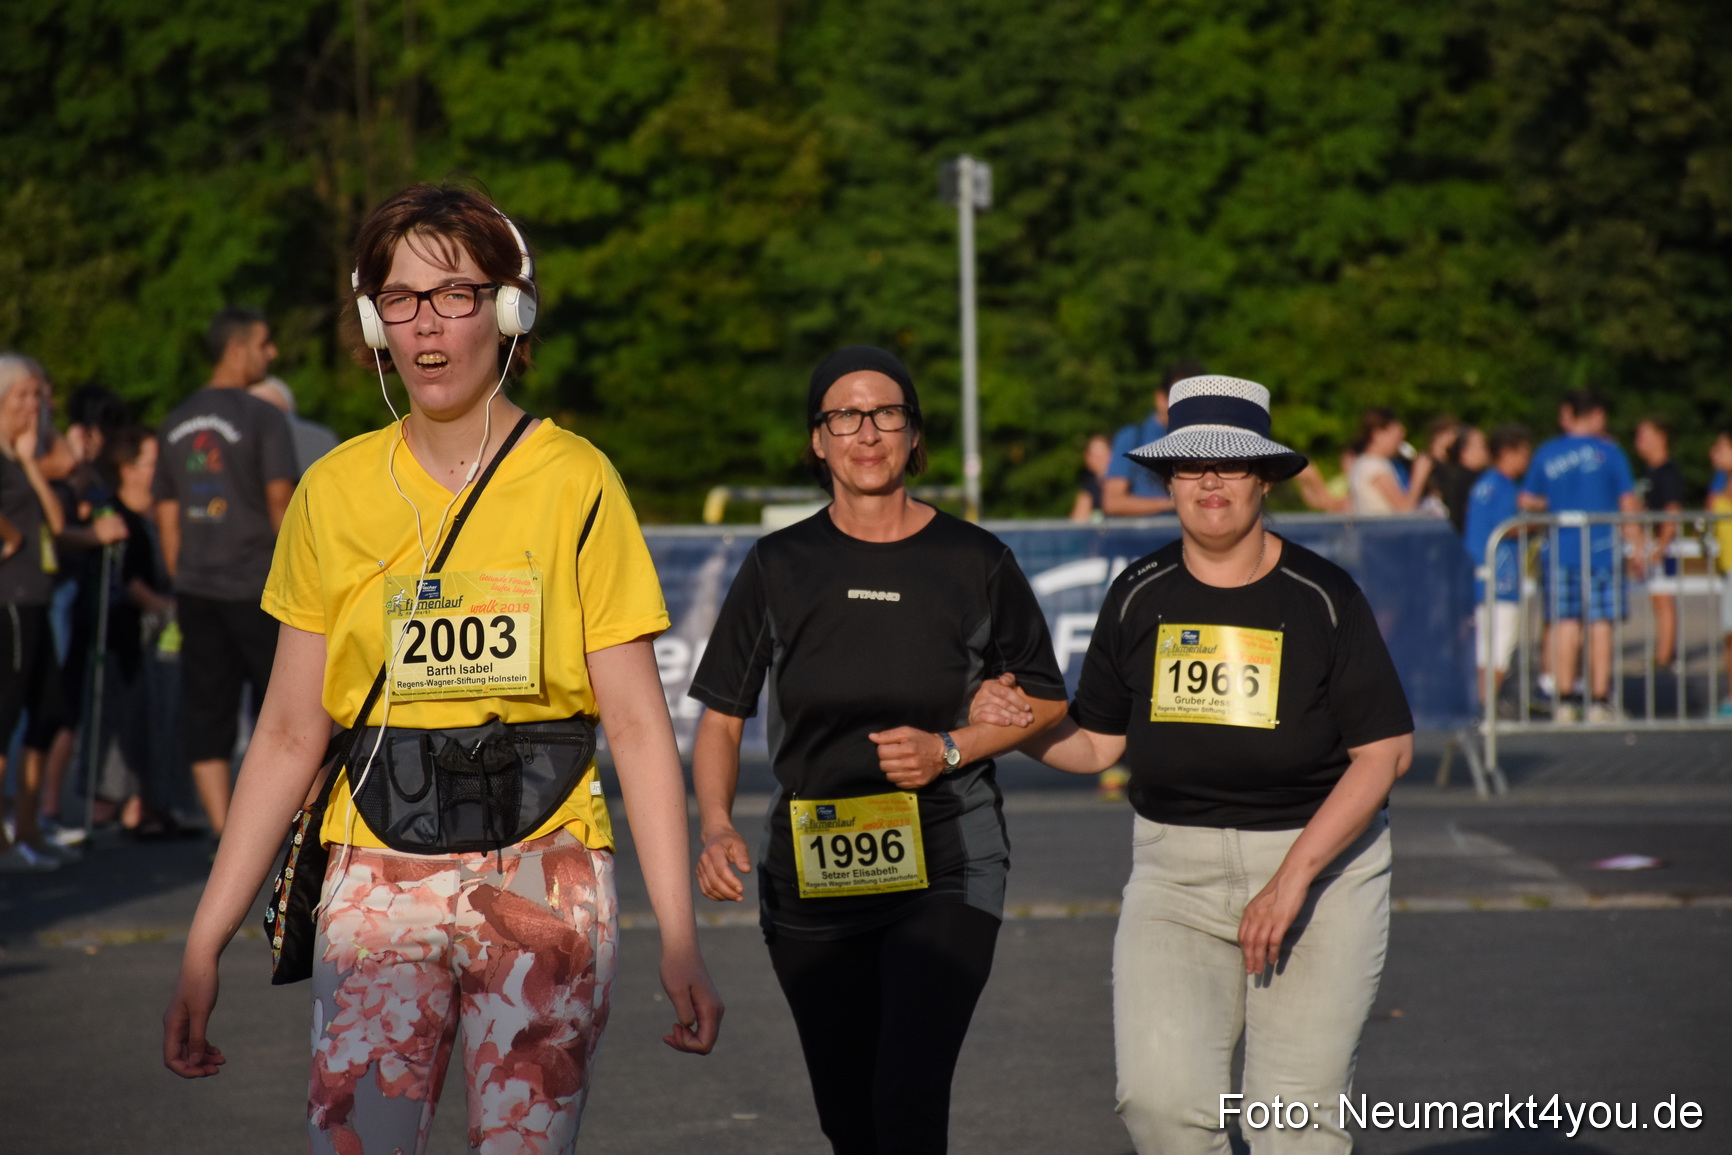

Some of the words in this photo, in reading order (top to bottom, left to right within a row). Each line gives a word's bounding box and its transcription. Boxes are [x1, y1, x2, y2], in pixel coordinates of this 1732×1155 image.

[405, 595, 464, 611] fimenlauf
[470, 600, 498, 614] walk
[500, 603, 530, 613] 2019
[402, 614, 517, 664] 2003
[1247, 655, 1272, 666] 2019
[426, 665, 456, 677] Barth
[459, 663, 493, 675] Isabel
[397, 677, 486, 690] Regens-Wagner-Stiftung
[488, 675, 527, 684] Holnstein
[1168, 660, 1260, 698] 1966
[1174, 696, 1206, 706] Gruber
[810, 829, 905, 869] 1996
[821, 871, 850, 880] Setzer
[852, 866, 898, 878] Elisabeth
[829, 880, 849, 888] Wagner
[853, 878, 878, 887] Stiftung
